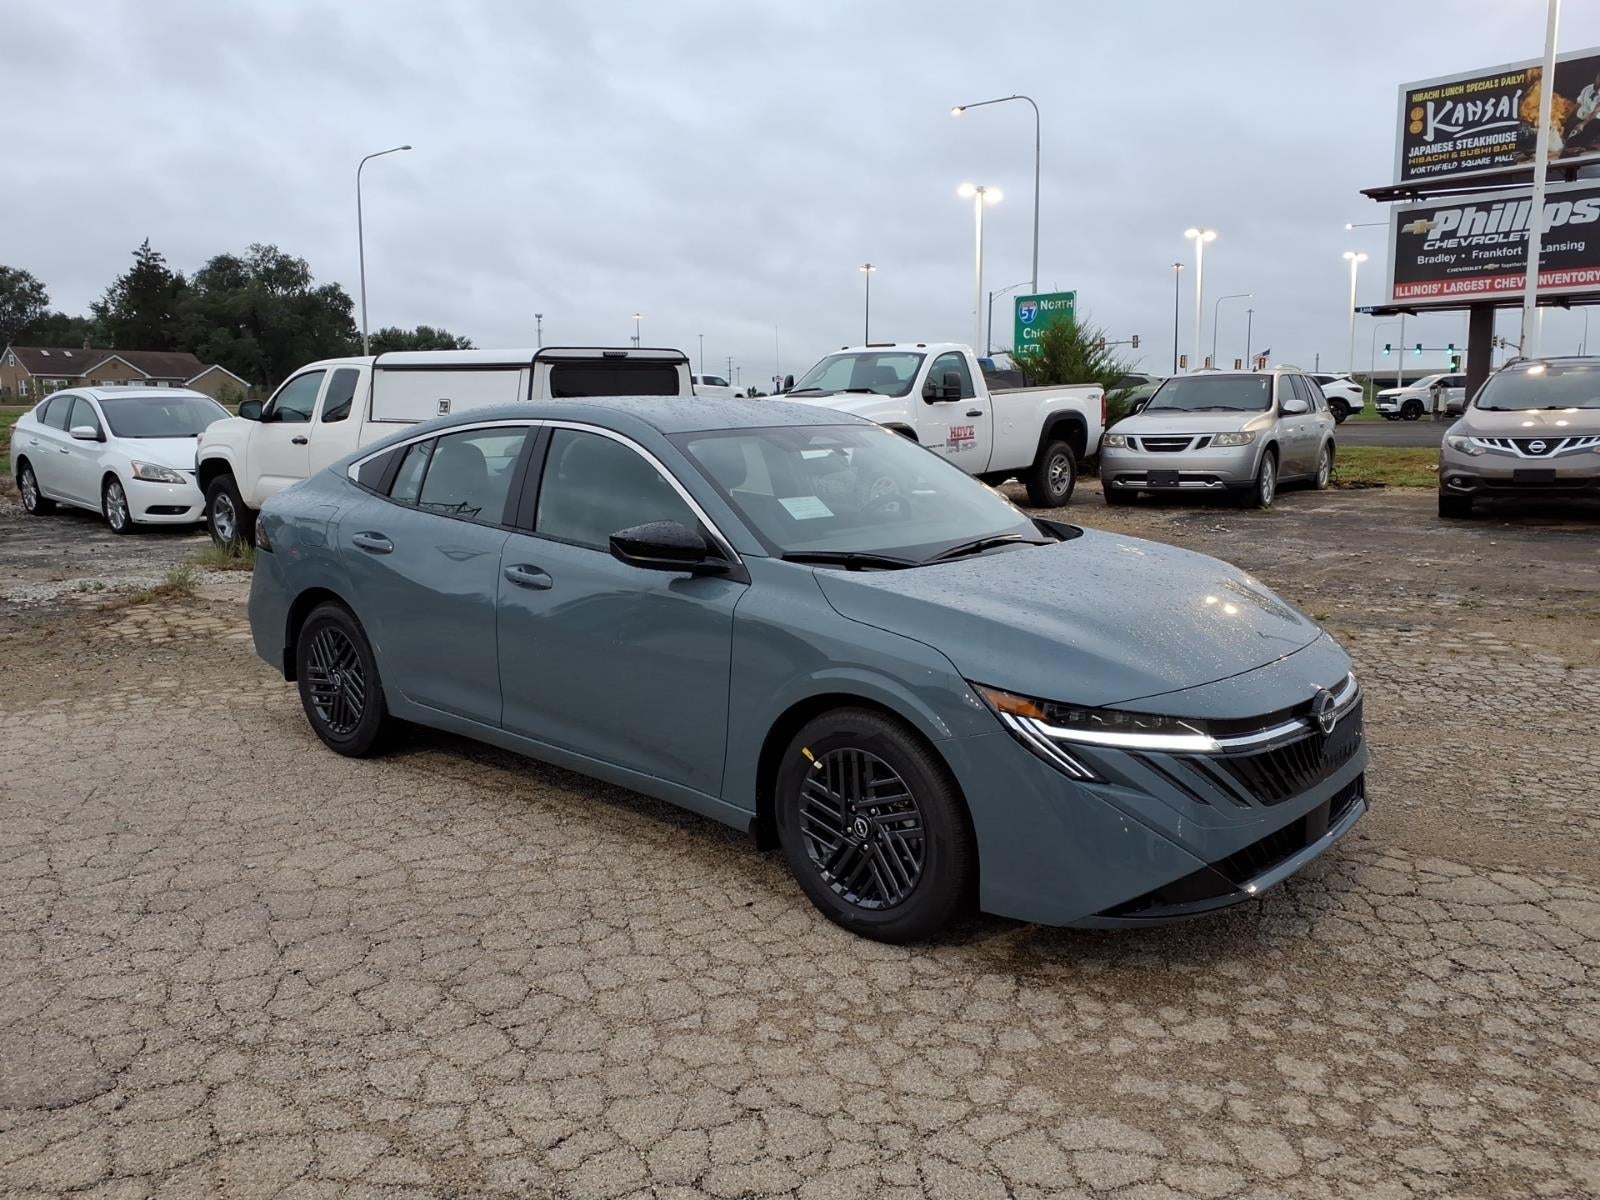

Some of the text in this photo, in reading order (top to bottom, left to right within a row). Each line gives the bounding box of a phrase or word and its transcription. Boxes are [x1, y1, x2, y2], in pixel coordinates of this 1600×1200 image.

[1412, 90, 1440, 102] HIBACHI
[1441, 85, 1464, 97] LUNCH
[1466, 79, 1499, 92] SPECIALS
[1408, 132, 1517, 157] JAPANESE STEAKHOUSE
[1408, 154, 1449, 165] HIBACHI
[1460, 147, 1492, 157] SUSHI
[1493, 143, 1516, 153] BAR
[1410, 154, 1514, 174] NORTHFIELD SQUARE MALL
[1423, 231, 1530, 250] CHEVROLET
[1417, 254, 1456, 264] Bradley
[1472, 246, 1522, 259] Frankfort
[1443, 280, 1491, 293] LARGEST
[1539, 270, 1600, 285] NVENTORY
[1021, 308, 1036, 320] 57
[1040, 299, 1073, 310] NORTH
[1018, 344, 1040, 353] LEFT
